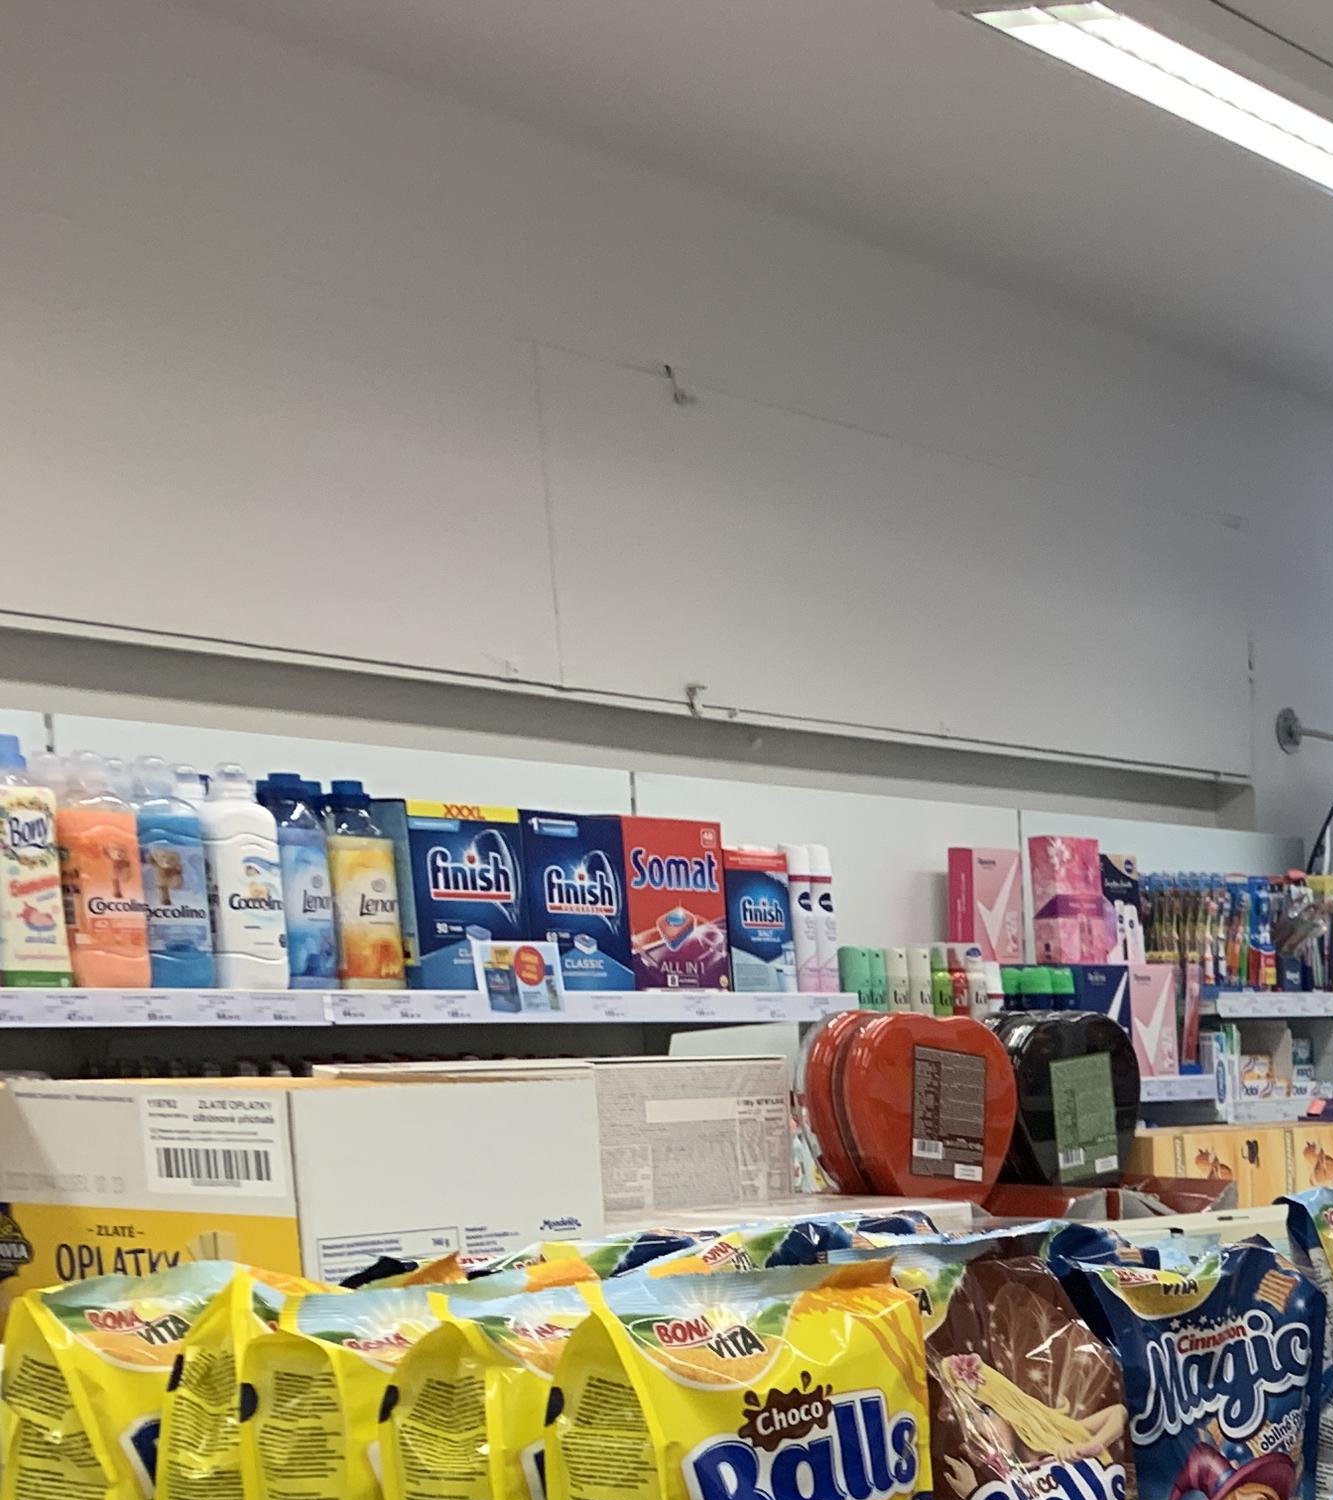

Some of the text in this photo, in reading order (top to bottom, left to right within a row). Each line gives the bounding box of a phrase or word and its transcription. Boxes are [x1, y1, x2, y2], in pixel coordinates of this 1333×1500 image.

[442, 804, 485, 819] XXXL
[427, 846, 512, 893] finish
[544, 865, 615, 908] finish
[631, 848, 719, 893] Somat
[740, 896, 784, 925] finish
[660, 960, 682, 974] ALL
[96, 1225, 135, 1238] ZLATÉ
[653, 1318, 767, 1360] BONA VITA
[1131, 1311, 1314, 1446] Magic
[754, 1399, 825, 1438] Choco
